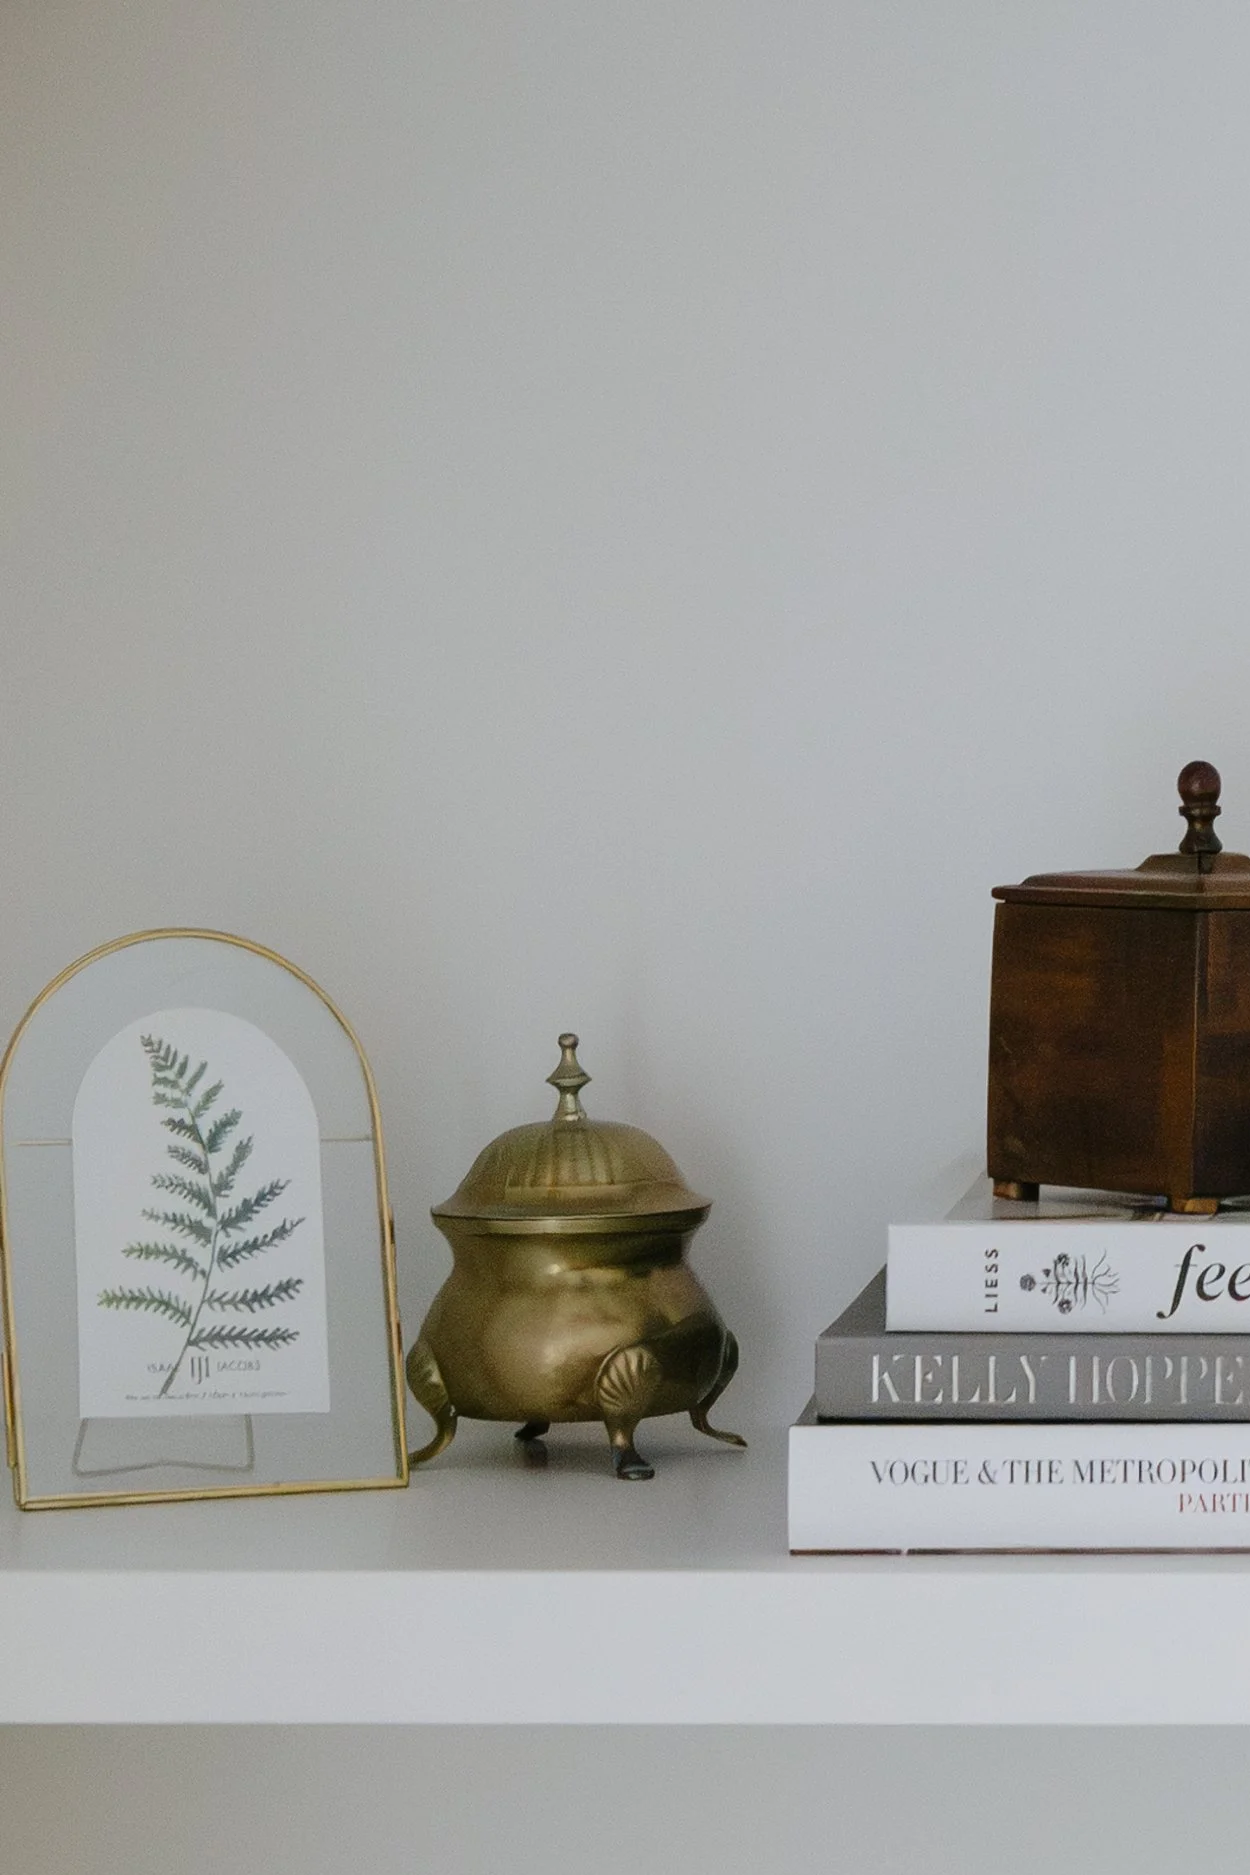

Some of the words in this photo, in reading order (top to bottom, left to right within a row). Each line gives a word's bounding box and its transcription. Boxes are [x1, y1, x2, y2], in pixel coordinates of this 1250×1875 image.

[983, 1248, 999, 1313] LIESS
[872, 1353, 1048, 1405] KELLY
[870, 1457, 969, 1485] VOGUE
[977, 1457, 998, 1485] &
[1001, 1457, 1065, 1485] THE
